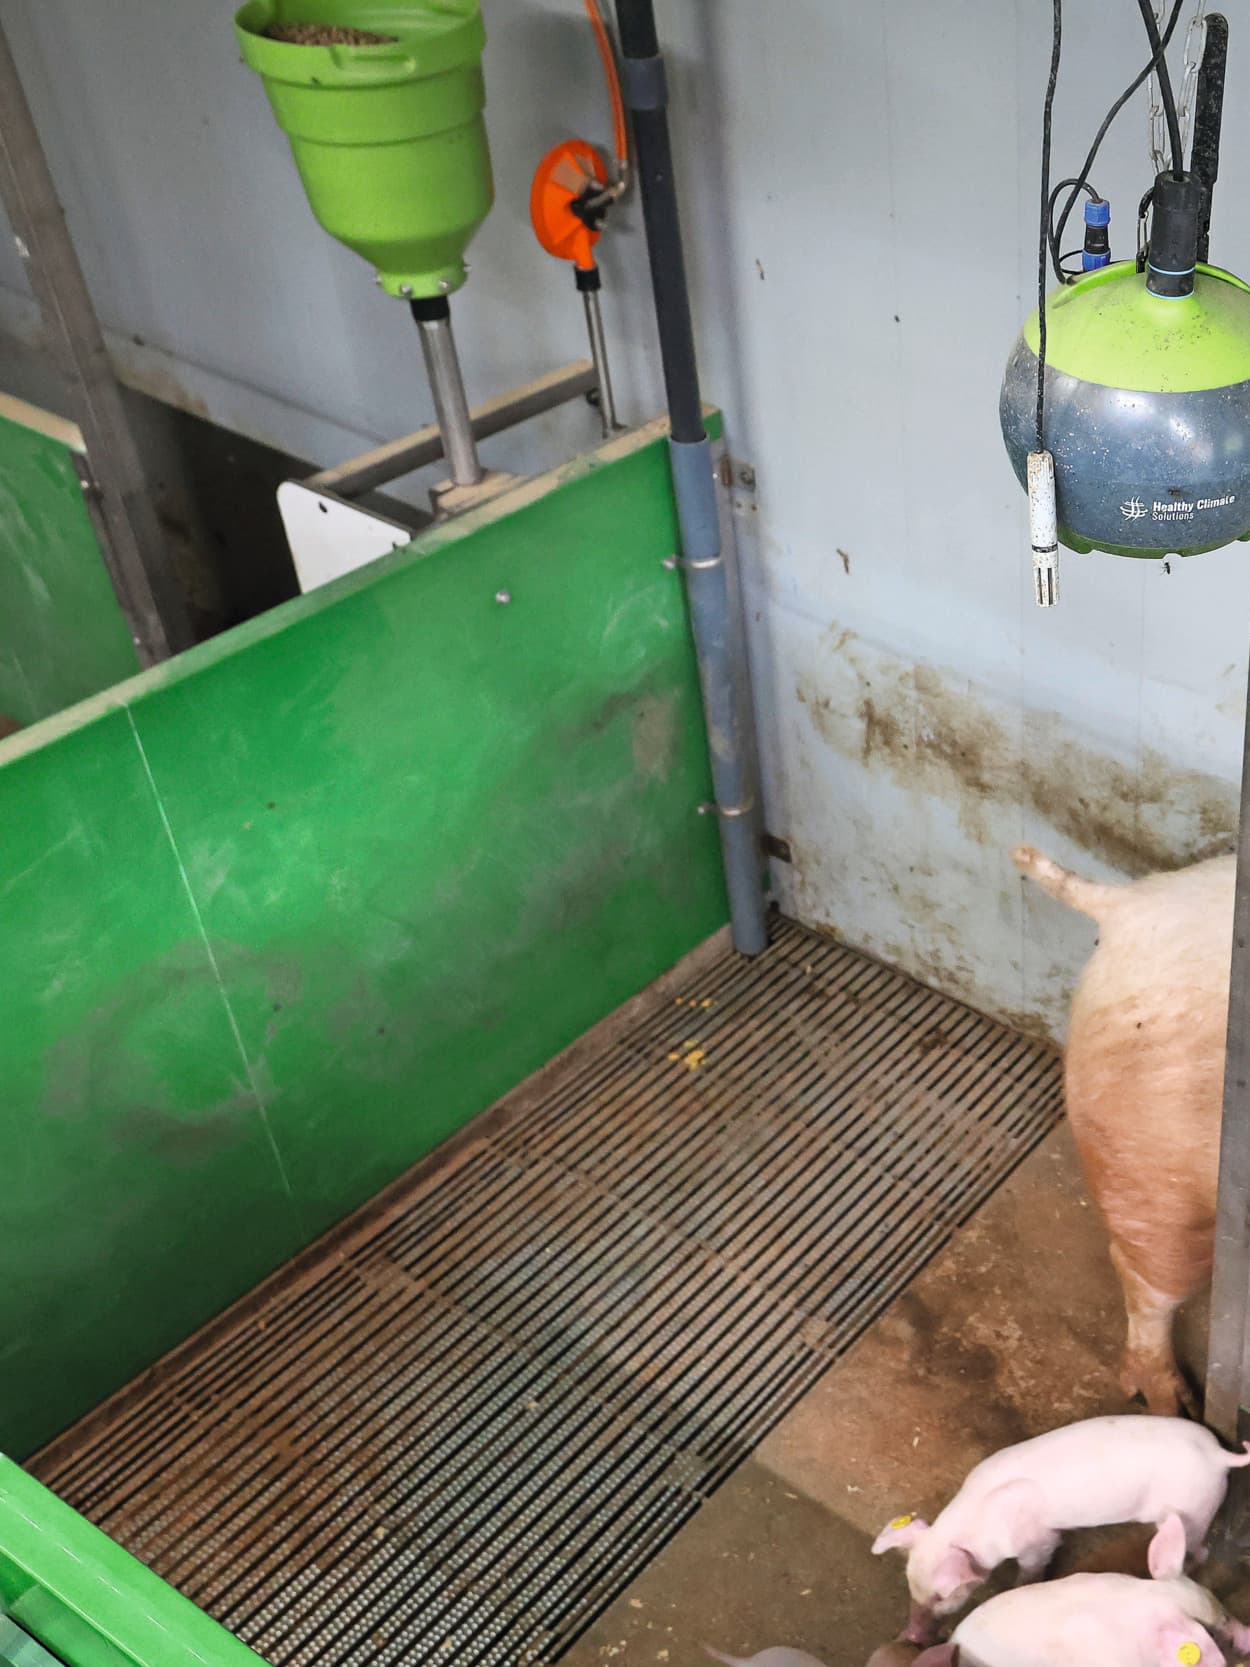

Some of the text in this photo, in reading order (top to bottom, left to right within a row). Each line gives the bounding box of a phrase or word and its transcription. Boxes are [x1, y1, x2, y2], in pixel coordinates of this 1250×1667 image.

[1153, 495, 1235, 512] Healthy Climate
[1152, 511, 1194, 521] Solutions
